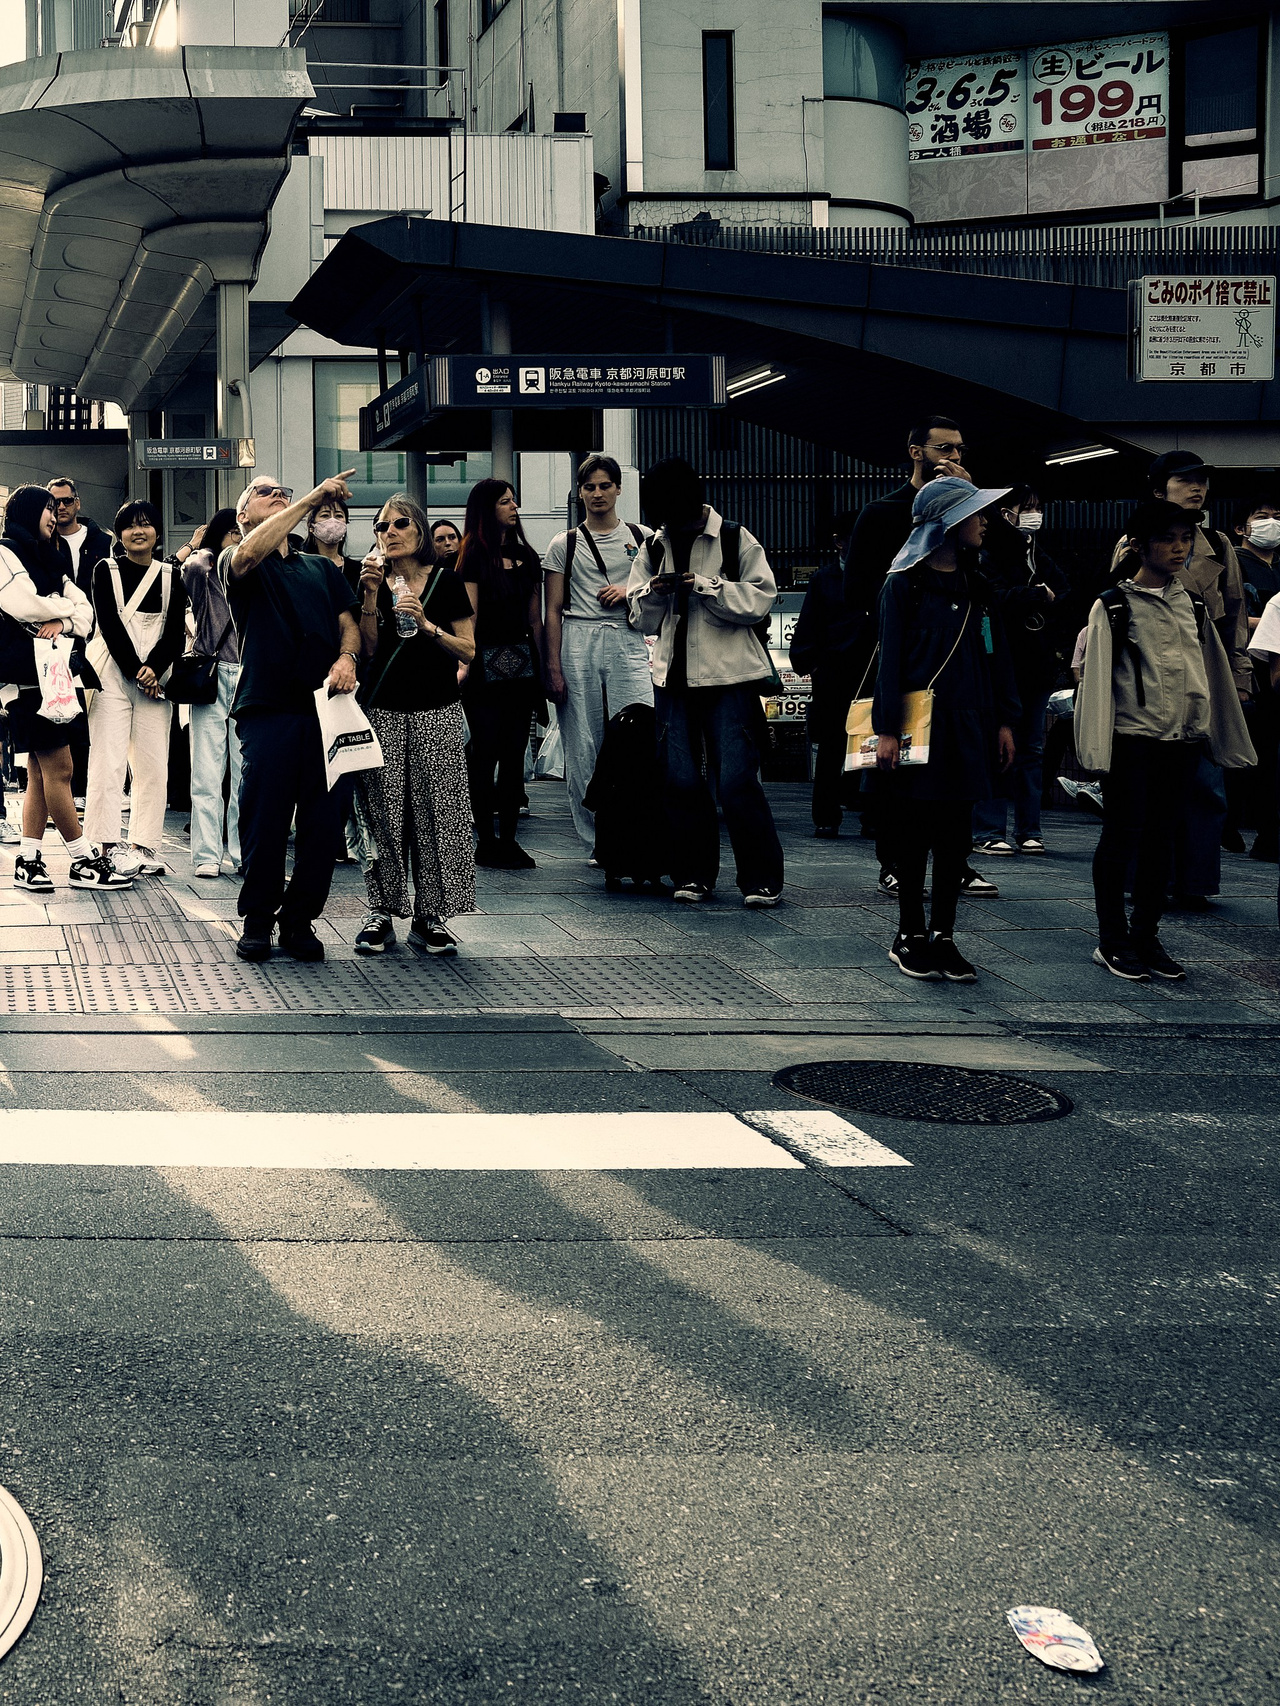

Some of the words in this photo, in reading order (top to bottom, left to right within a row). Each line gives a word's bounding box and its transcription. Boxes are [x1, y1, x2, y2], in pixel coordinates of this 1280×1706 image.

[1038, 55, 1067, 79] 生
[1076, 50, 1165, 80] ビール
[931, 108, 992, 144] 酒場
[1050, 129, 1147, 148] お通しなし
[1148, 279, 1271, 305] ごみのポイ捨て禁止
[549, 367, 602, 380] 阪急電車
[606, 367, 686, 380] 京都河原町駅
[1170, 362, 1246, 376] 京都市
[549, 380, 571, 388] Hankyu
[572, 380, 594, 388] Railway
[348, 732, 370, 742] TABLE
